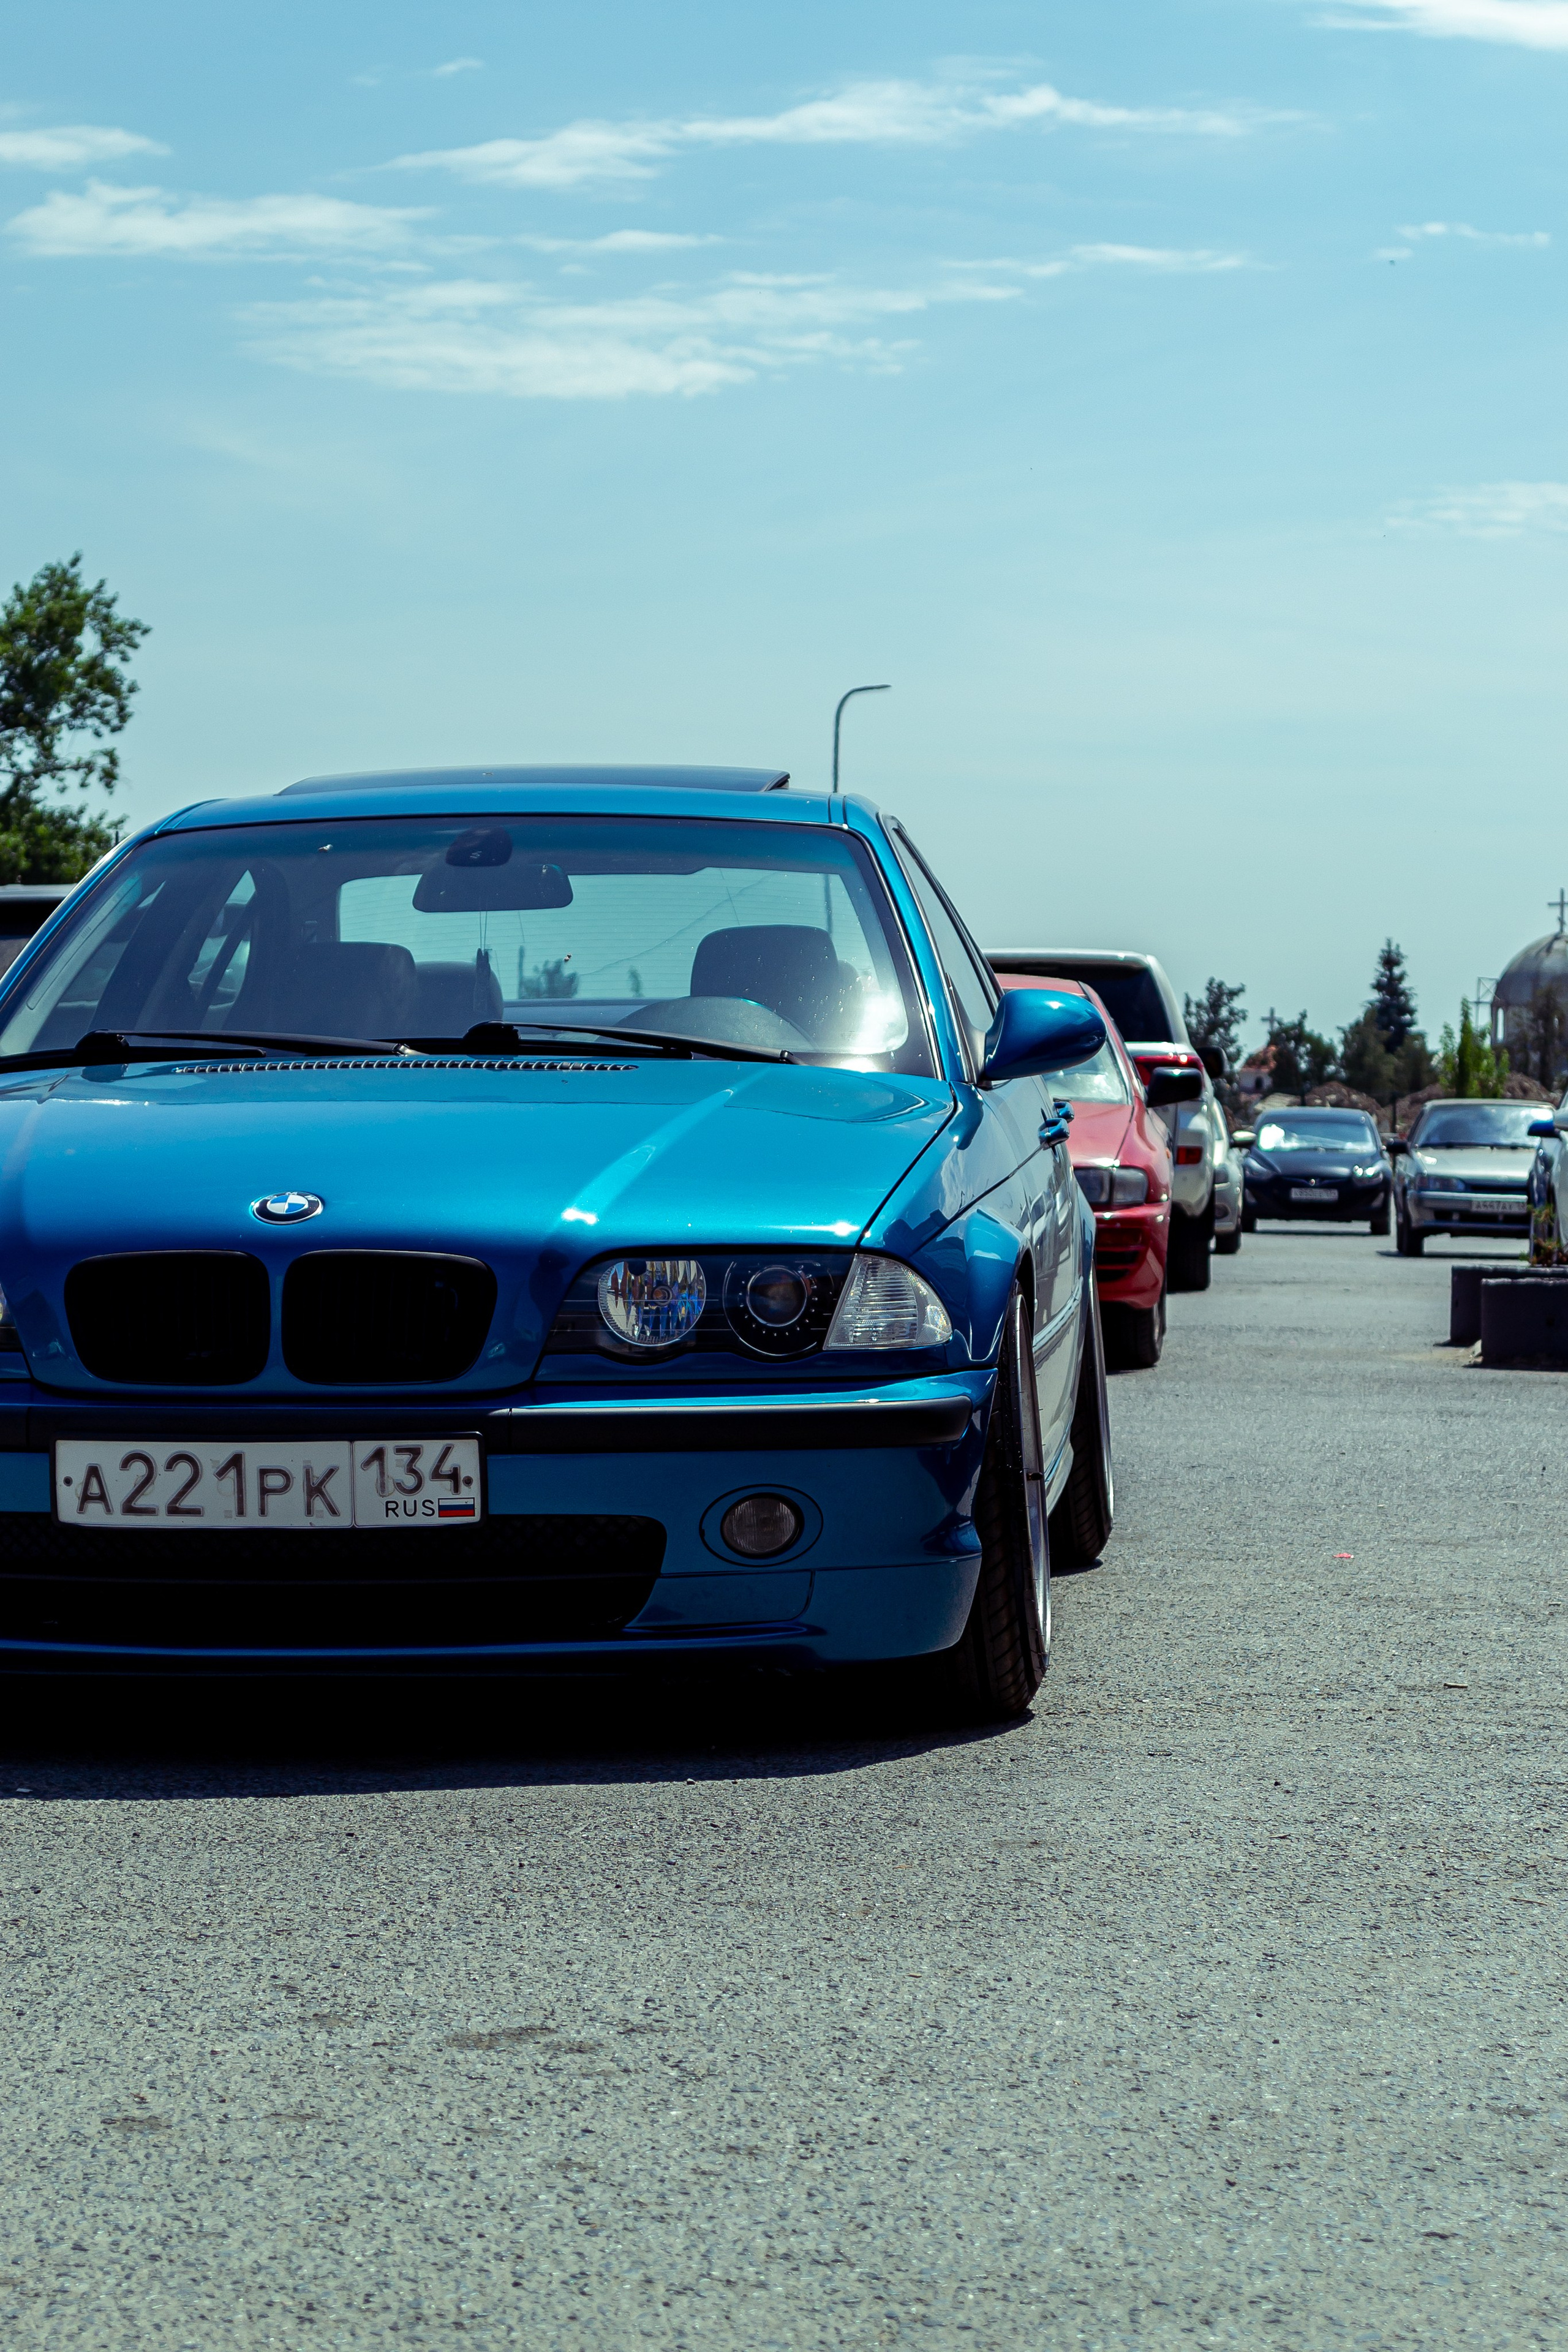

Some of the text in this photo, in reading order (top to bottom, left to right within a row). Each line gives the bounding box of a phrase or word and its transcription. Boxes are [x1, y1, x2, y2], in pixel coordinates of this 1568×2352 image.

[265, 1191, 317, 1201] BMW
[78, 1446, 462, 1518] А221РК 134
[385, 1499, 435, 1517] RUS
